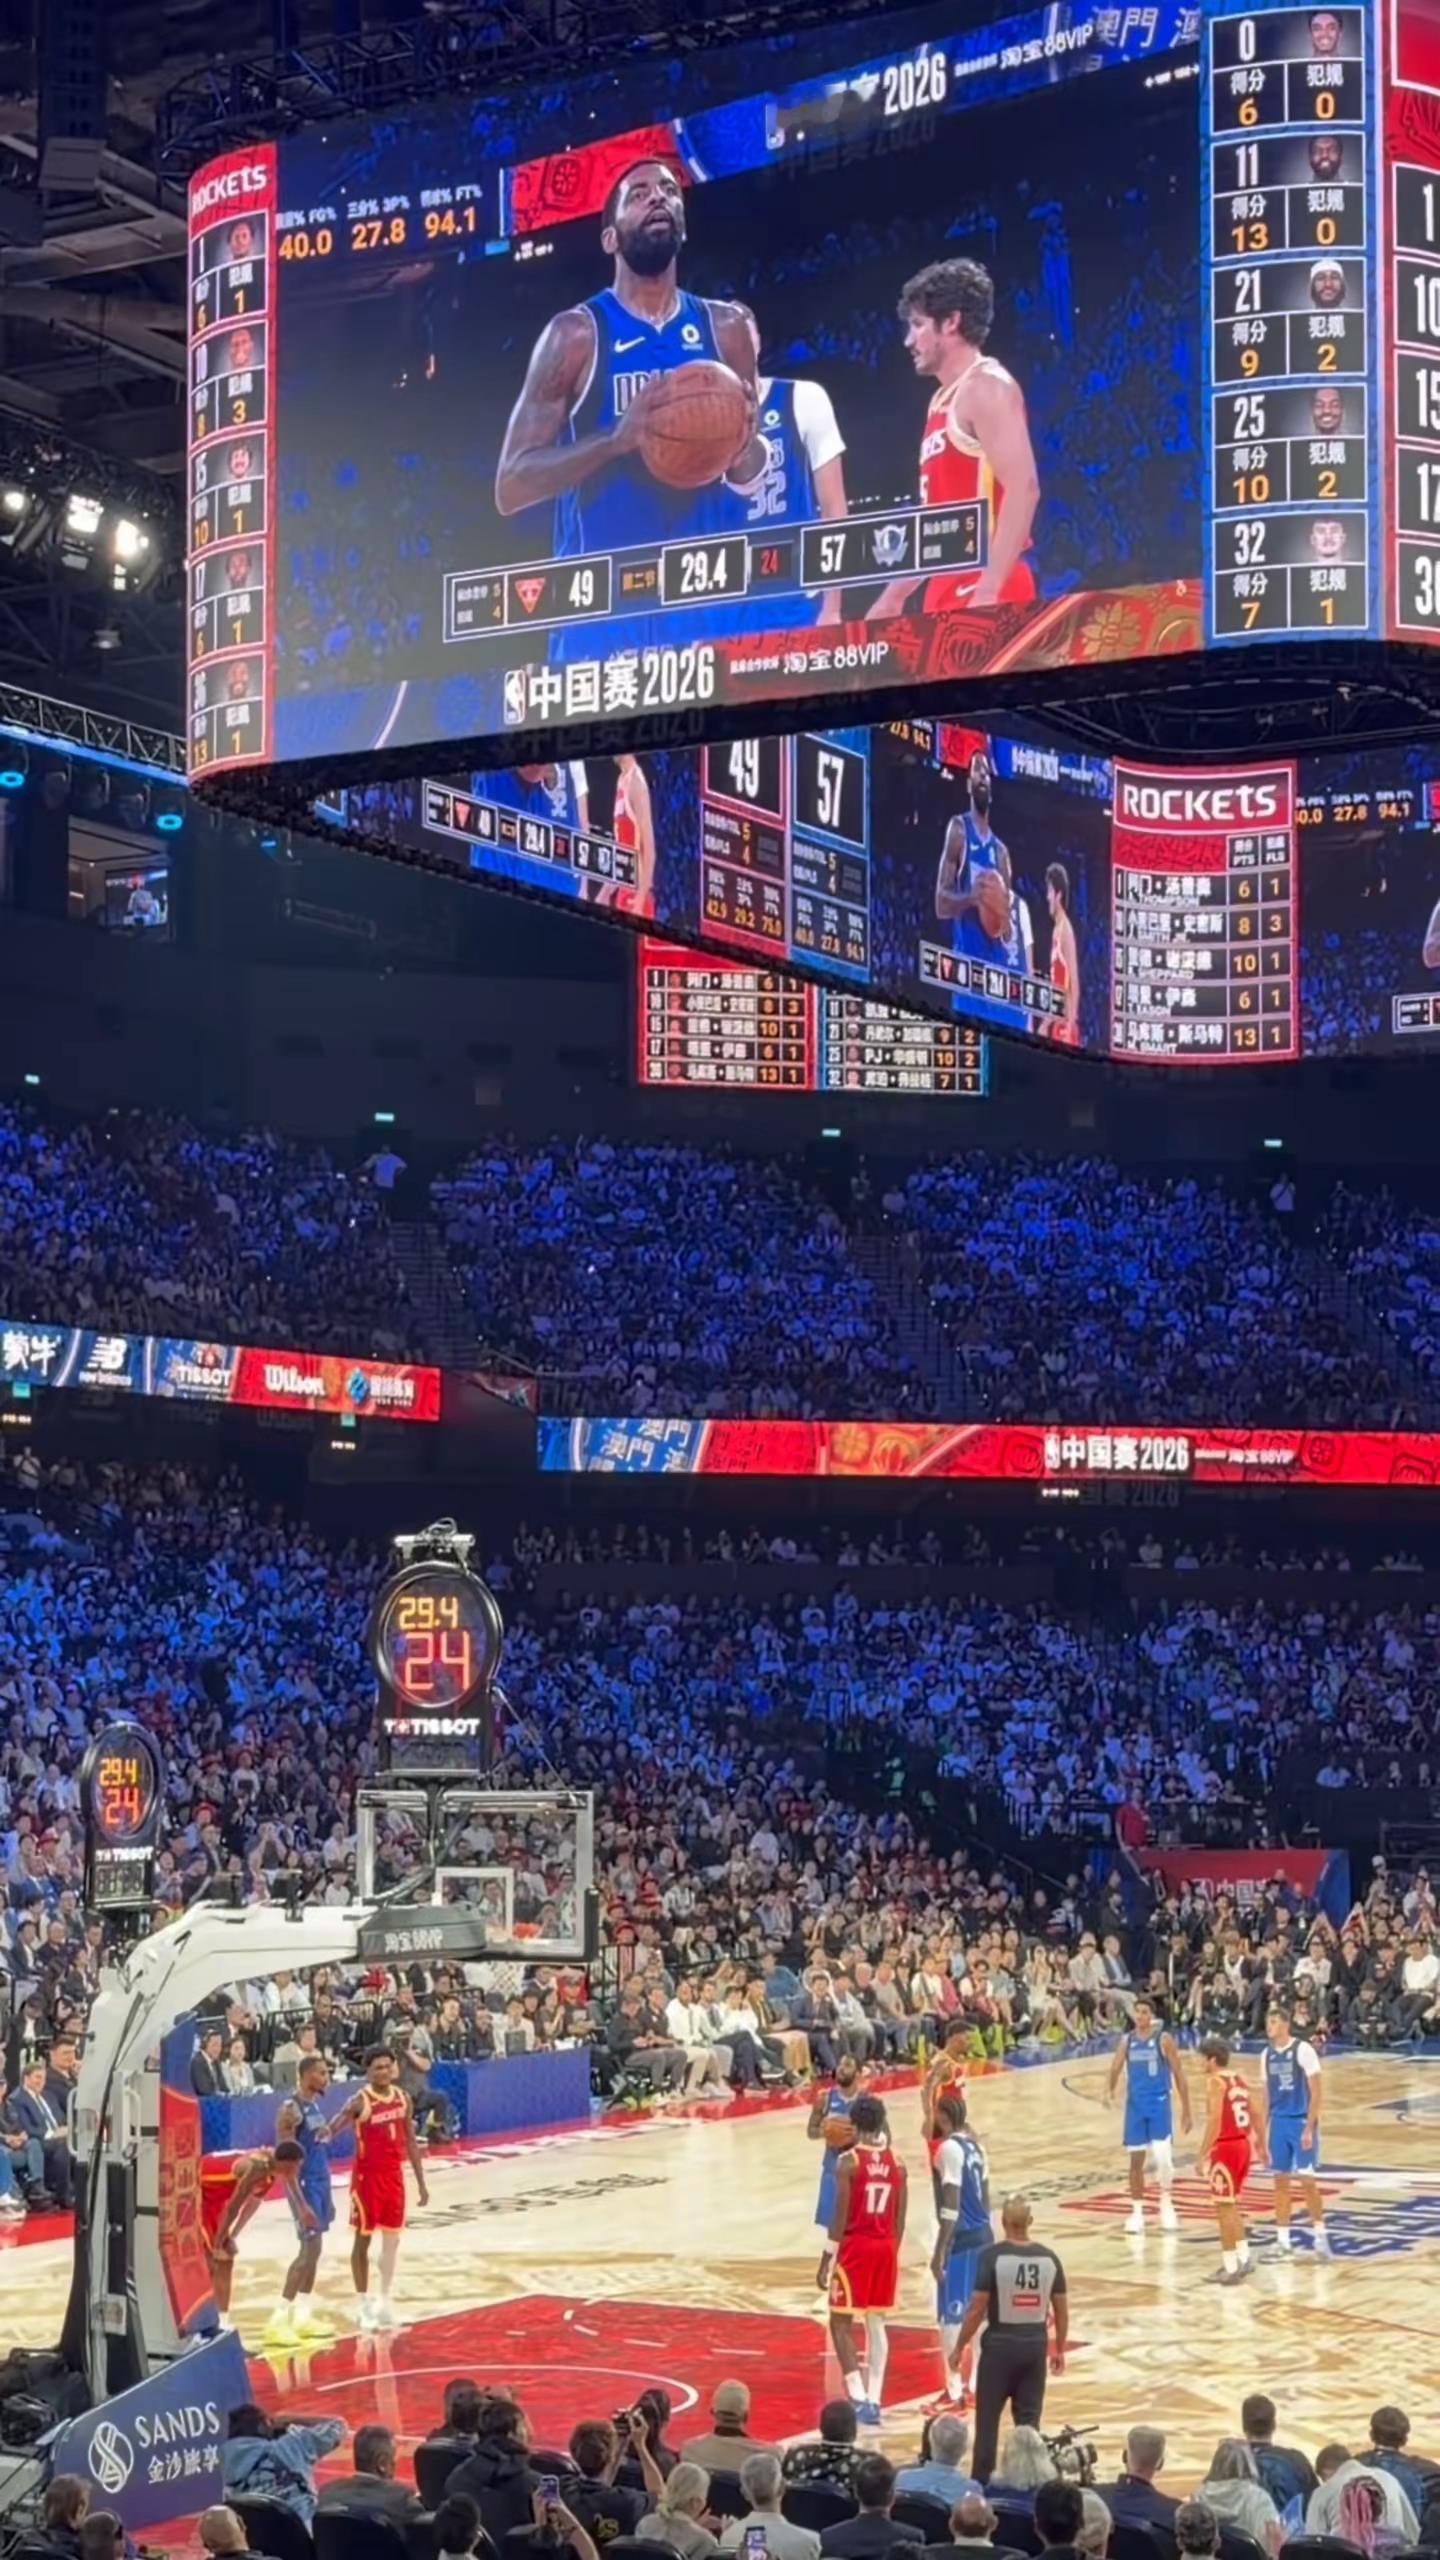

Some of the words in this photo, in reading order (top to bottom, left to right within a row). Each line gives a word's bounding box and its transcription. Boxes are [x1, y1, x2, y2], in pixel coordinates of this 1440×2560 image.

[1239, 19, 1255, 62] 0
[1231, 69, 1265, 94] 得分
[1239, 98, 1258, 125] 6
[1315, 92, 1335, 119] 0
[1236, 144, 1259, 188] 11
[425, 206, 476, 239] 94.1
[1231, 194, 1266, 219] 得分
[279, 229, 332, 261] 40.0
[352, 217, 405, 250] 27.8
[1232, 223, 1268, 252] 13
[1316, 218, 1336, 245] 0
[234, 290, 244, 313] 1
[1235, 269, 1261, 313] 21
[1232, 320, 1267, 346] 得分
[1240, 350, 1259, 377] 9
[1317, 344, 1337, 371] 2
[233, 400, 246, 424] 3
[1234, 394, 1265, 439] 25
[1233, 446, 1268, 472] 得分
[1233, 475, 1269, 504] 10
[1318, 471, 1337, 497] 2
[233, 510, 242, 533] 1
[965, 516, 975, 531] 5
[820, 534, 846, 574] 57
[1234, 521, 1266, 565] 32
[680, 549, 727, 594] 29.4
[1233, 572, 1268, 597] 得分
[569, 570, 594, 607] 49
[1241, 602, 1260, 629] 7
[1320, 598, 1334, 625] 1
[232, 620, 242, 644] 1
[783, 641, 889, 674] 淘宝88VIP
[529, 646, 714, 720] 中国赛2026
[232, 730, 241, 753] 1
[729, 739, 759, 798] 49
[817, 750, 844, 827] 57
[1123, 784, 1277, 821] ROCKETS
[1238, 881, 1250, 898] 6
[1270, 878, 1279, 895] 1
[1270, 915, 1282, 932] 3
[1233, 954, 1256, 973] 10
[1271, 952, 1280, 969] 1
[789, 978, 797, 991] 1
[1239, 991, 1250, 1009] 6
[1271, 989, 1280, 1006] 1
[760, 1022, 777, 1036] 10
[789, 1024, 797, 1037] 1
[964, 1029, 975, 1043] 2
[1234, 1028, 1256, 1046] 13
[1271, 1026, 1280, 1044] 1
[789, 1046, 797, 1059] 1
[936, 1053, 953, 1065] 10
[964, 1053, 975, 1066] 2
[760, 1068, 777, 1081] 13
[789, 1069, 797, 1081] 1
[939, 1075, 950, 1088] 7
[964, 1076, 972, 1089] 1
[264, 1364, 325, 1396] Wilson
[601, 1428, 654, 1468] 澳門
[1062, 1434, 1189, 1470] 中国赛2026
[400, 1596, 459, 1629] 29.4
[405, 1630, 470, 1690] 24
[100, 1757, 137, 1787] 29.4
[106, 1787, 139, 1824] 24
[864, 2182, 892, 2214] 17
[1015, 2263, 1039, 2290] 43
[135, 2401, 220, 2448] SANDS
[147, 2444, 220, 2484] 金沙旅享
